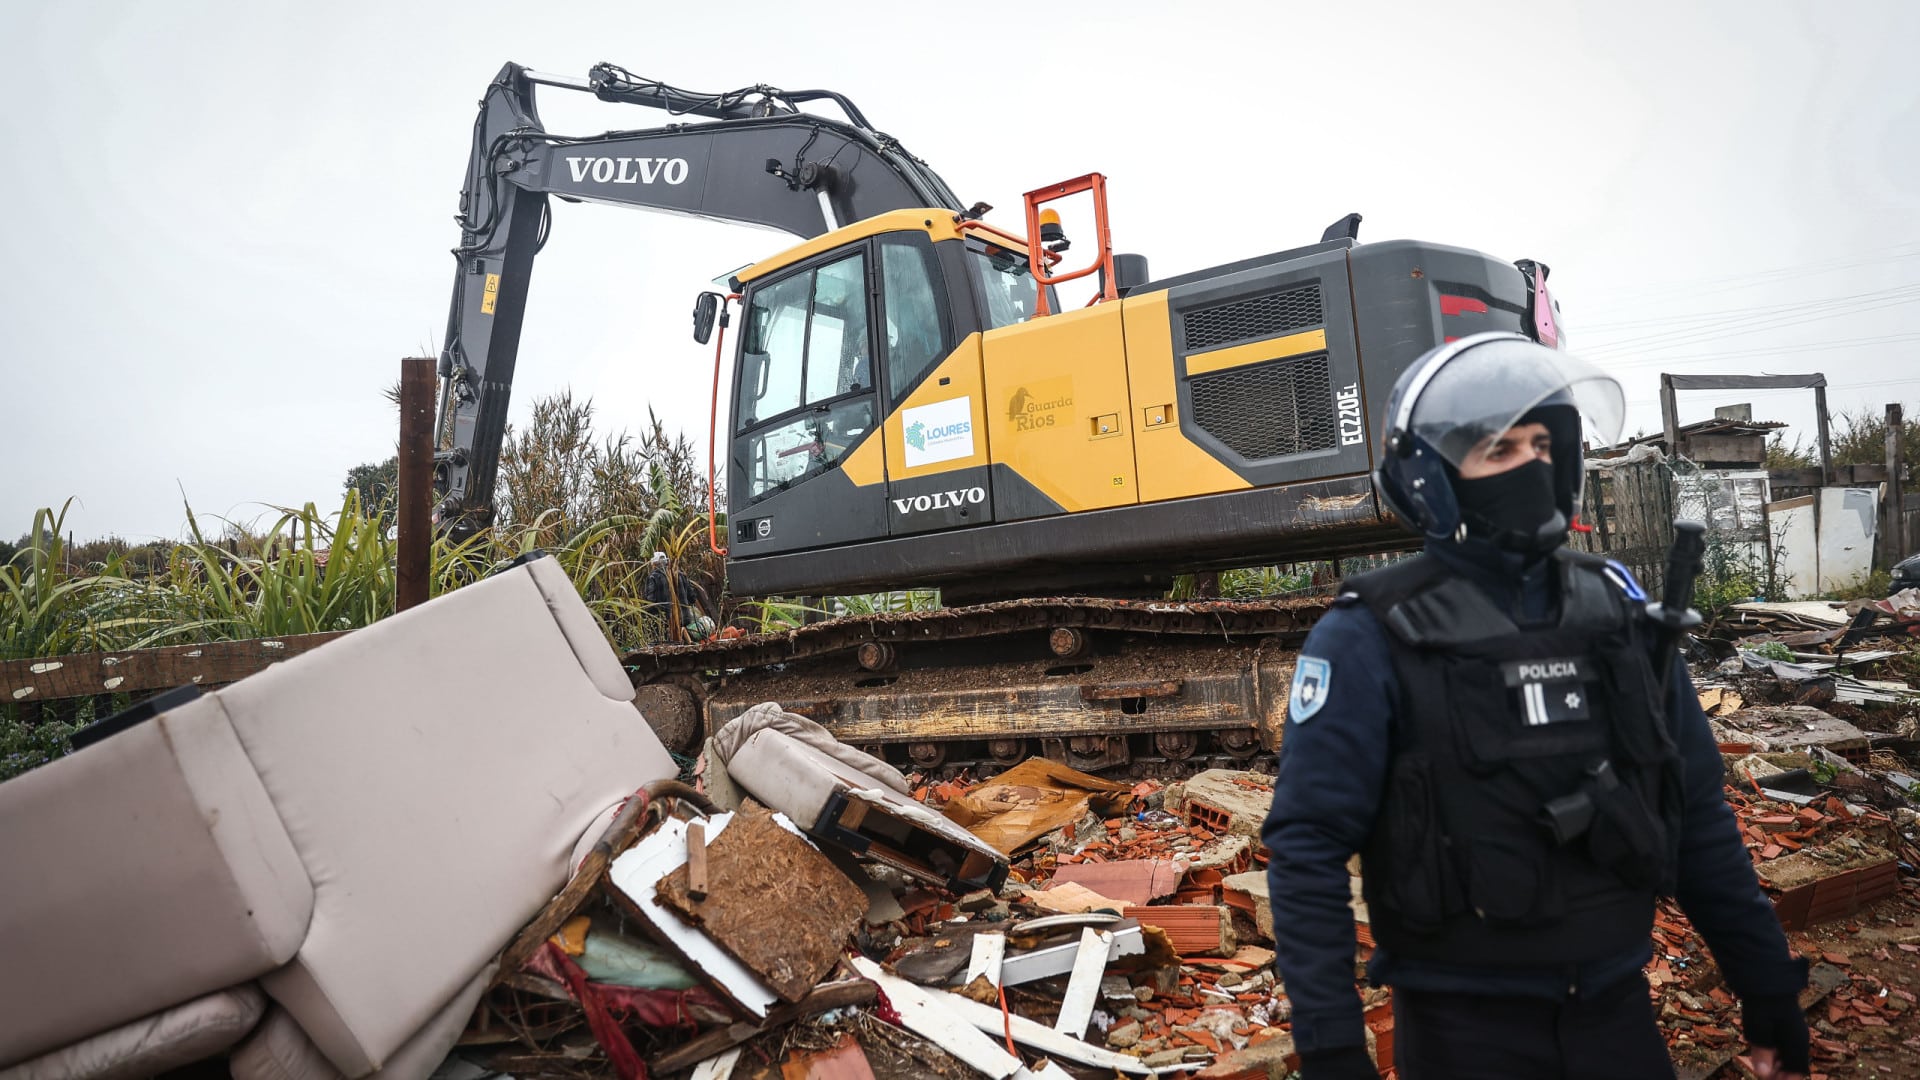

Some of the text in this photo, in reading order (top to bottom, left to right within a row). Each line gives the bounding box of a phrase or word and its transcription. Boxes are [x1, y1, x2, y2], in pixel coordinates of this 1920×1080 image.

[565, 157, 689, 185] VOLVO
[1027, 396, 1073, 413] Guarda
[926, 421, 971, 440] LOURES
[1016, 414, 1055, 432] Rios
[892, 487, 985, 514] VOLVO
[1519, 661, 1577, 680] POLICIA
